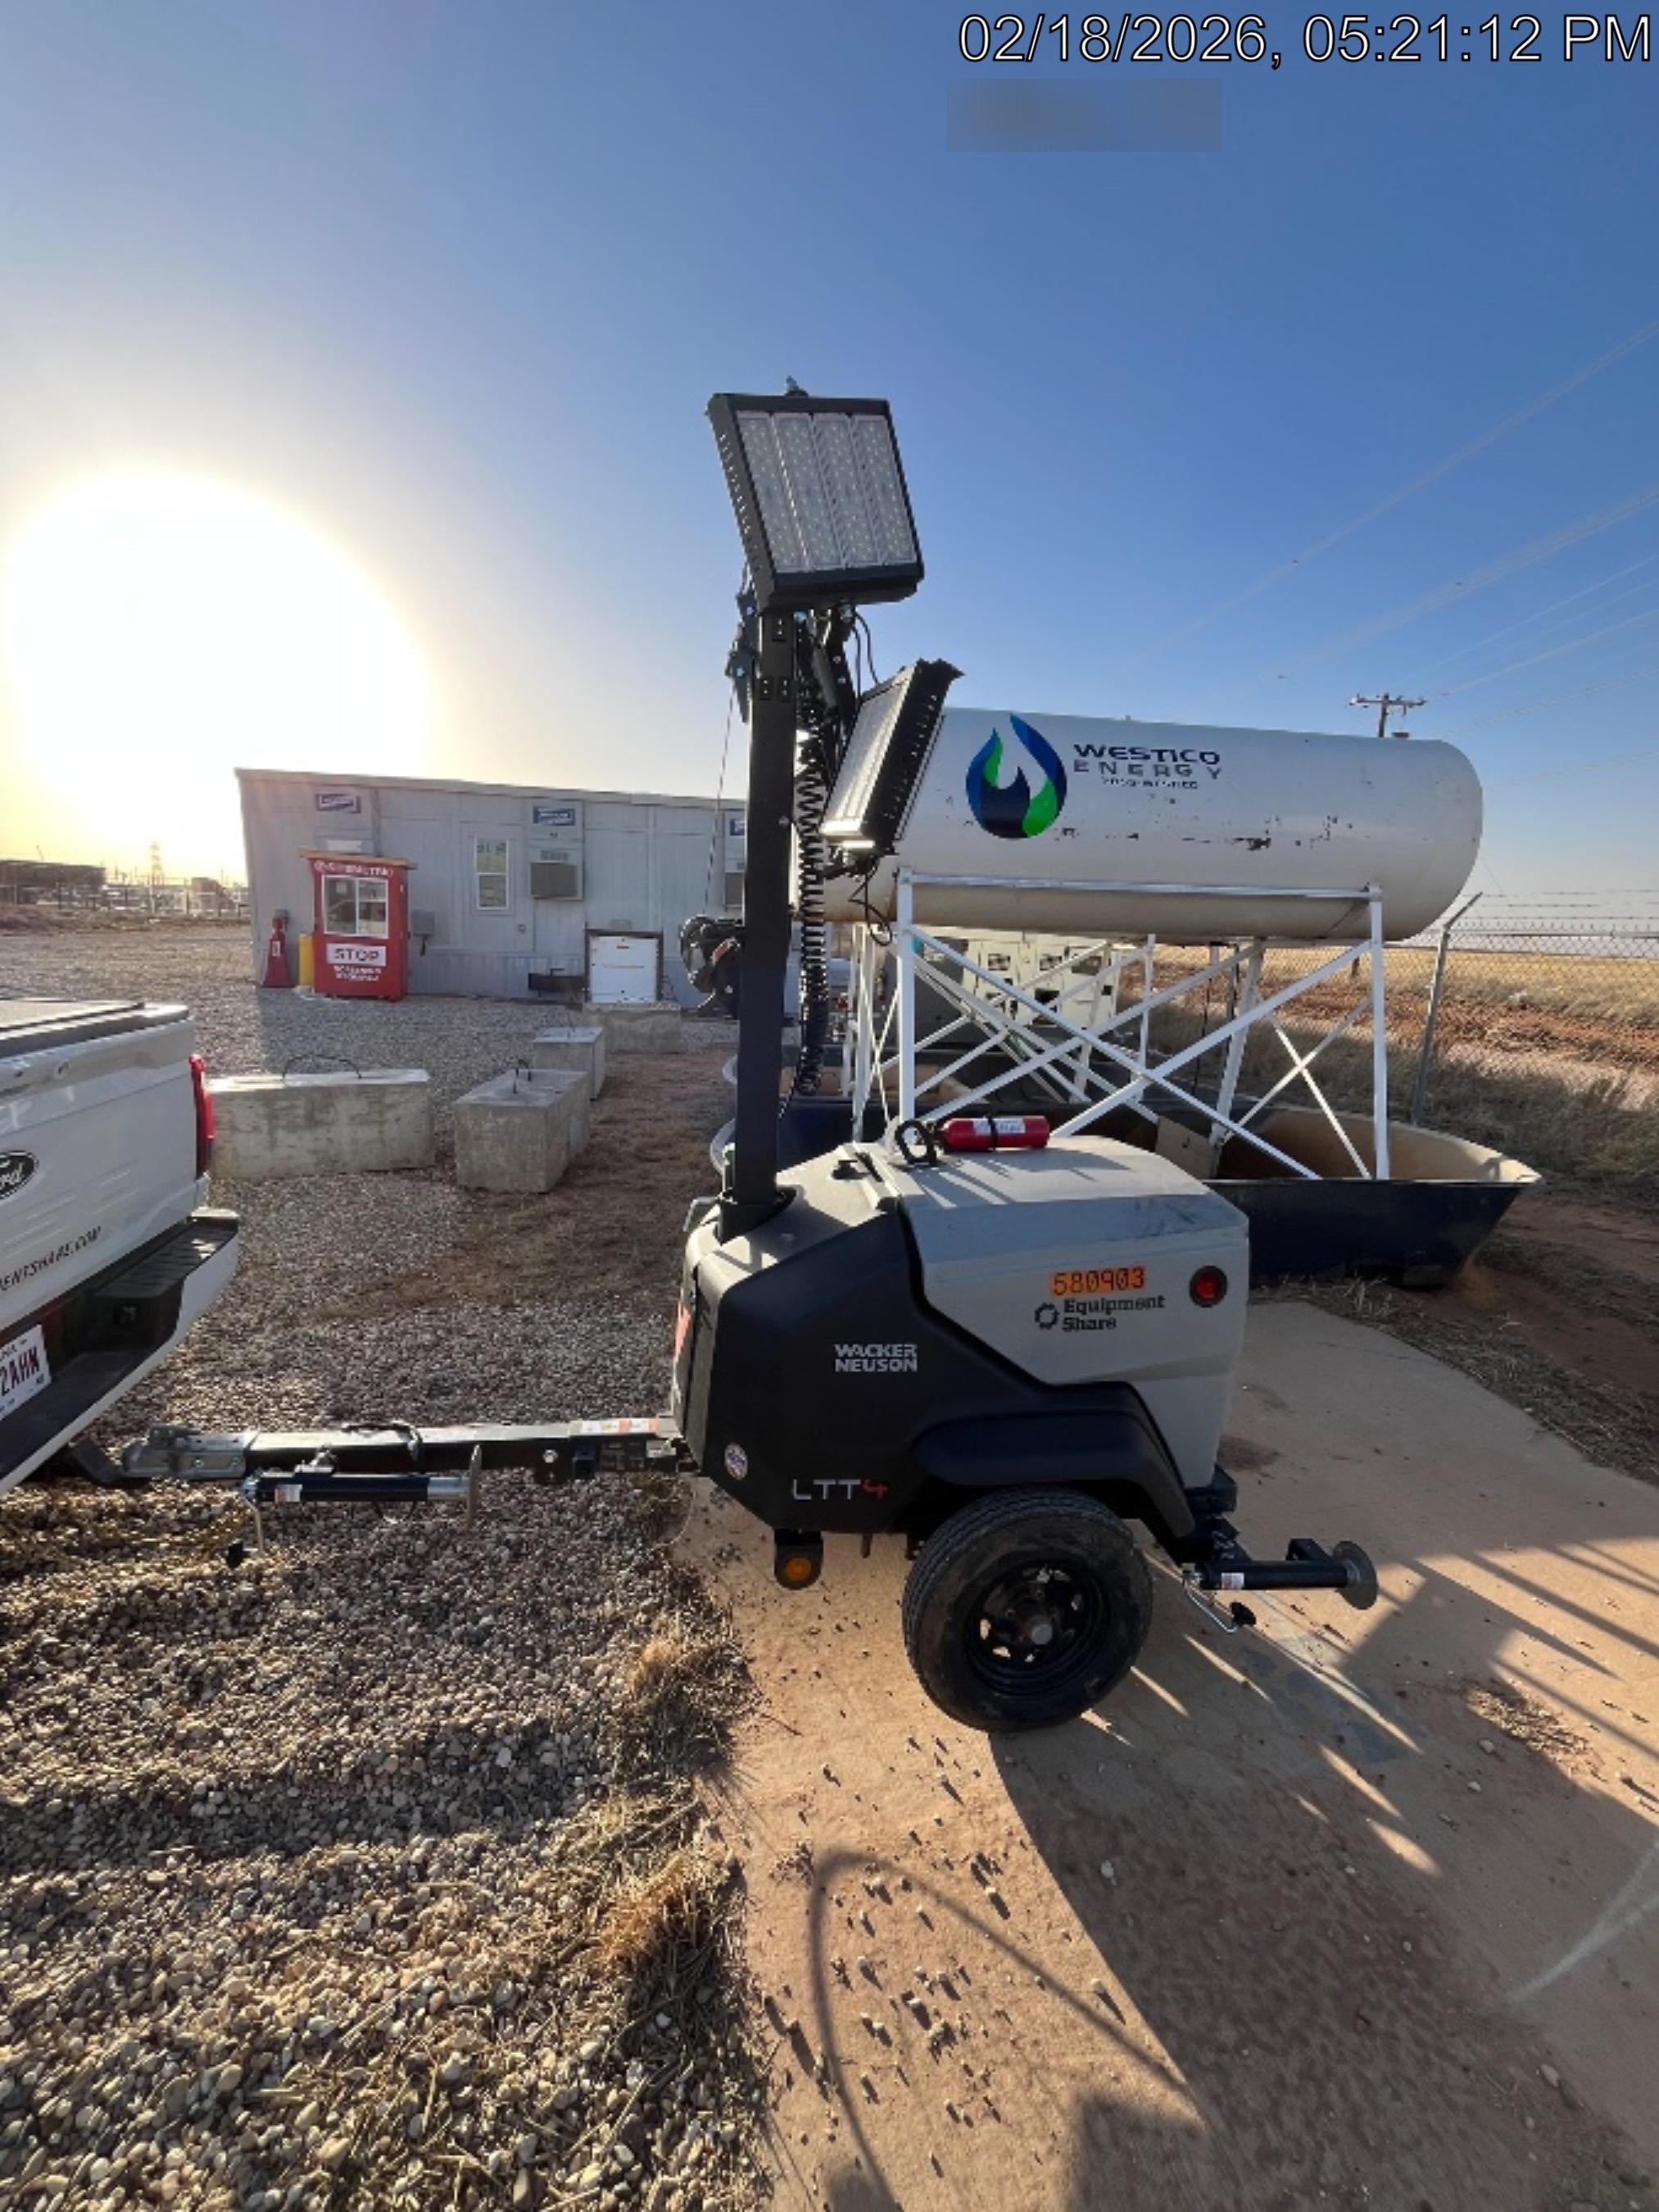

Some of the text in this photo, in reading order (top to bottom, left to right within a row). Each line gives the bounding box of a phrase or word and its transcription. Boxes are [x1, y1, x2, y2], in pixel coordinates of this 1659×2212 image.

[1073, 743, 1220, 765] WESTICO
[1073, 759, 1222, 779] ENERGY
[333, 948, 379, 962] STOP
[1053, 1268, 1145, 1295] 580903
[1063, 1294, 1165, 1315] Equipment
[1063, 1316, 1117, 1331] Share
[834, 1344, 918, 1358] WACKER
[835, 1358, 918, 1372] NEUSON
[791, 1478, 888, 1501] LTT4
